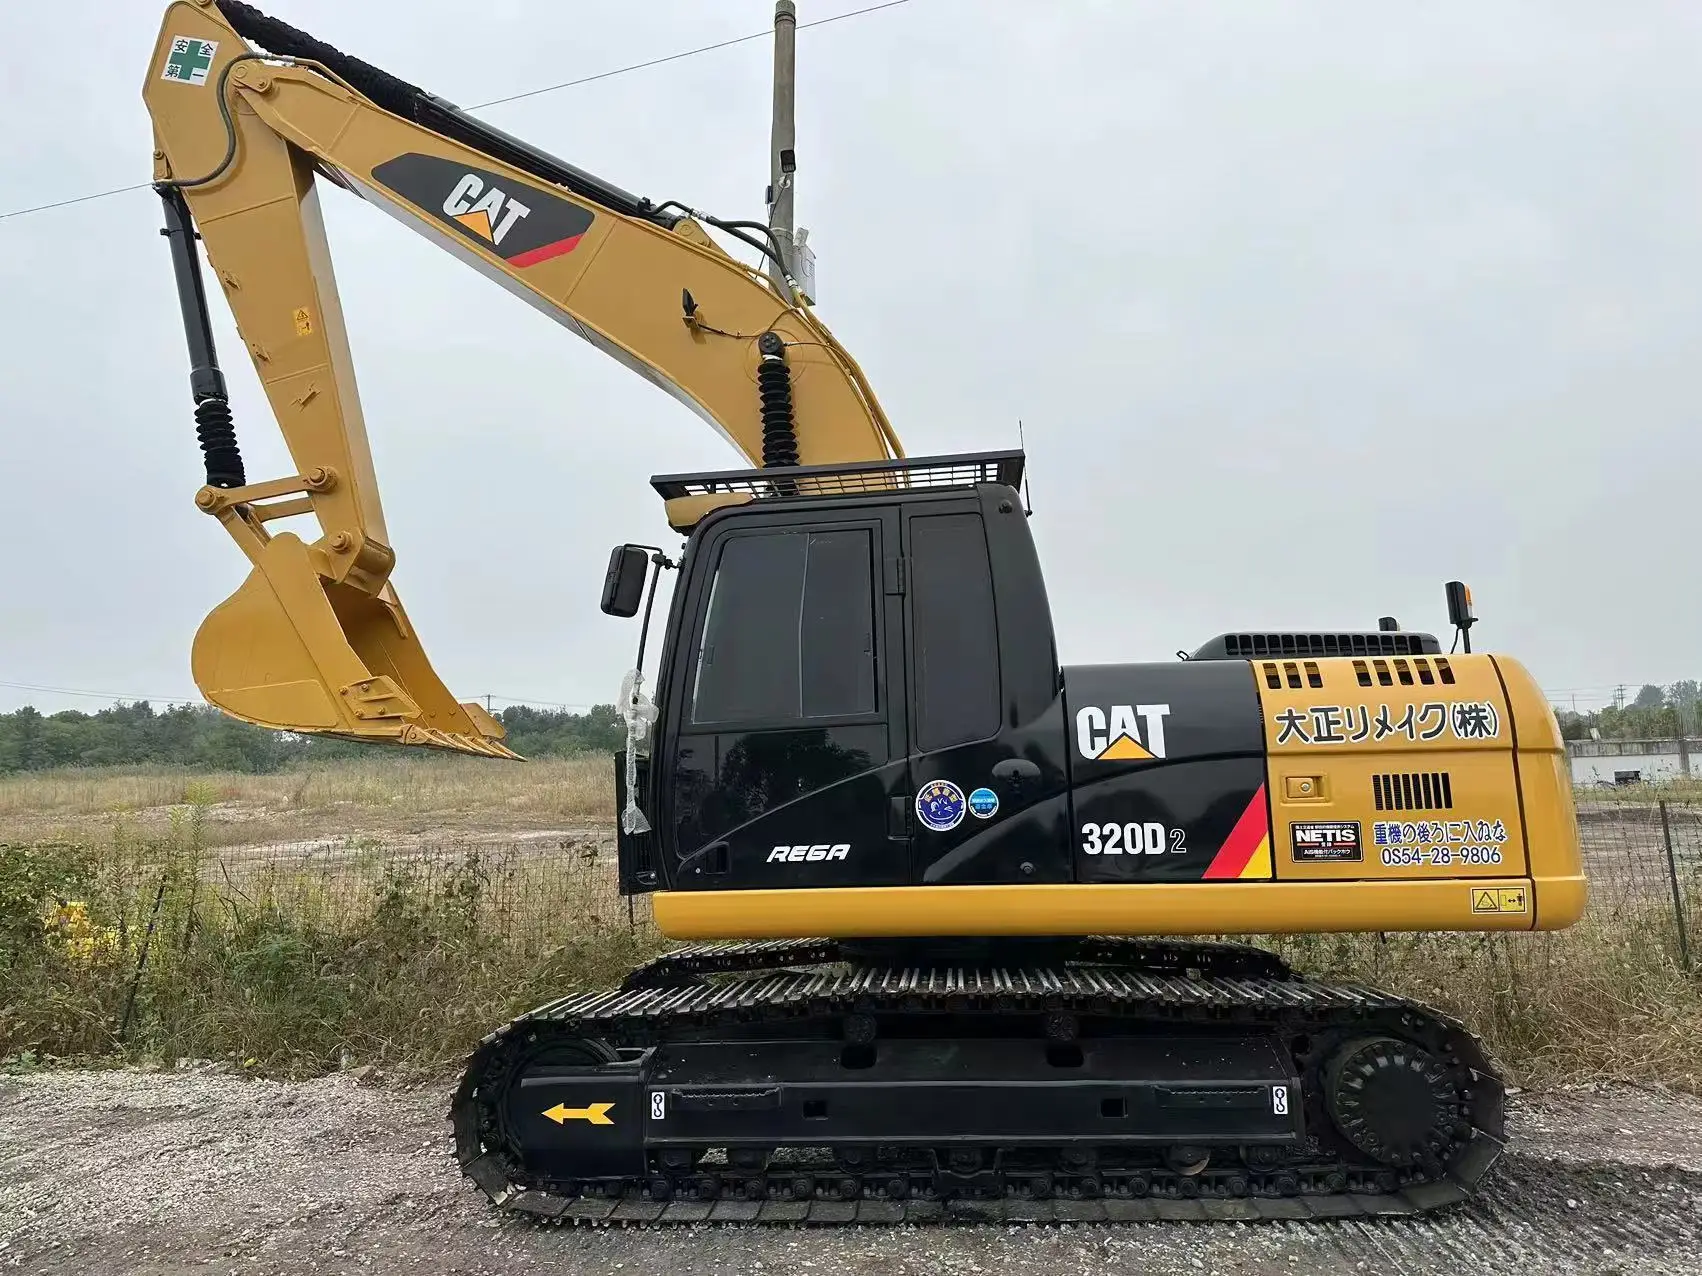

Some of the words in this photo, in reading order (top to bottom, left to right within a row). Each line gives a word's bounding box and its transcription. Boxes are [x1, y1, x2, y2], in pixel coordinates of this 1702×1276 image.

[174, 39, 214, 56] 安全
[165, 64, 204, 78] 第一
[442, 173, 531, 246] CAT
[1076, 704, 1171, 760] CAT
[1081, 822, 1166, 855] 320D
[1295, 829, 1356, 842] NETIS
[766, 844, 851, 862] REGA
